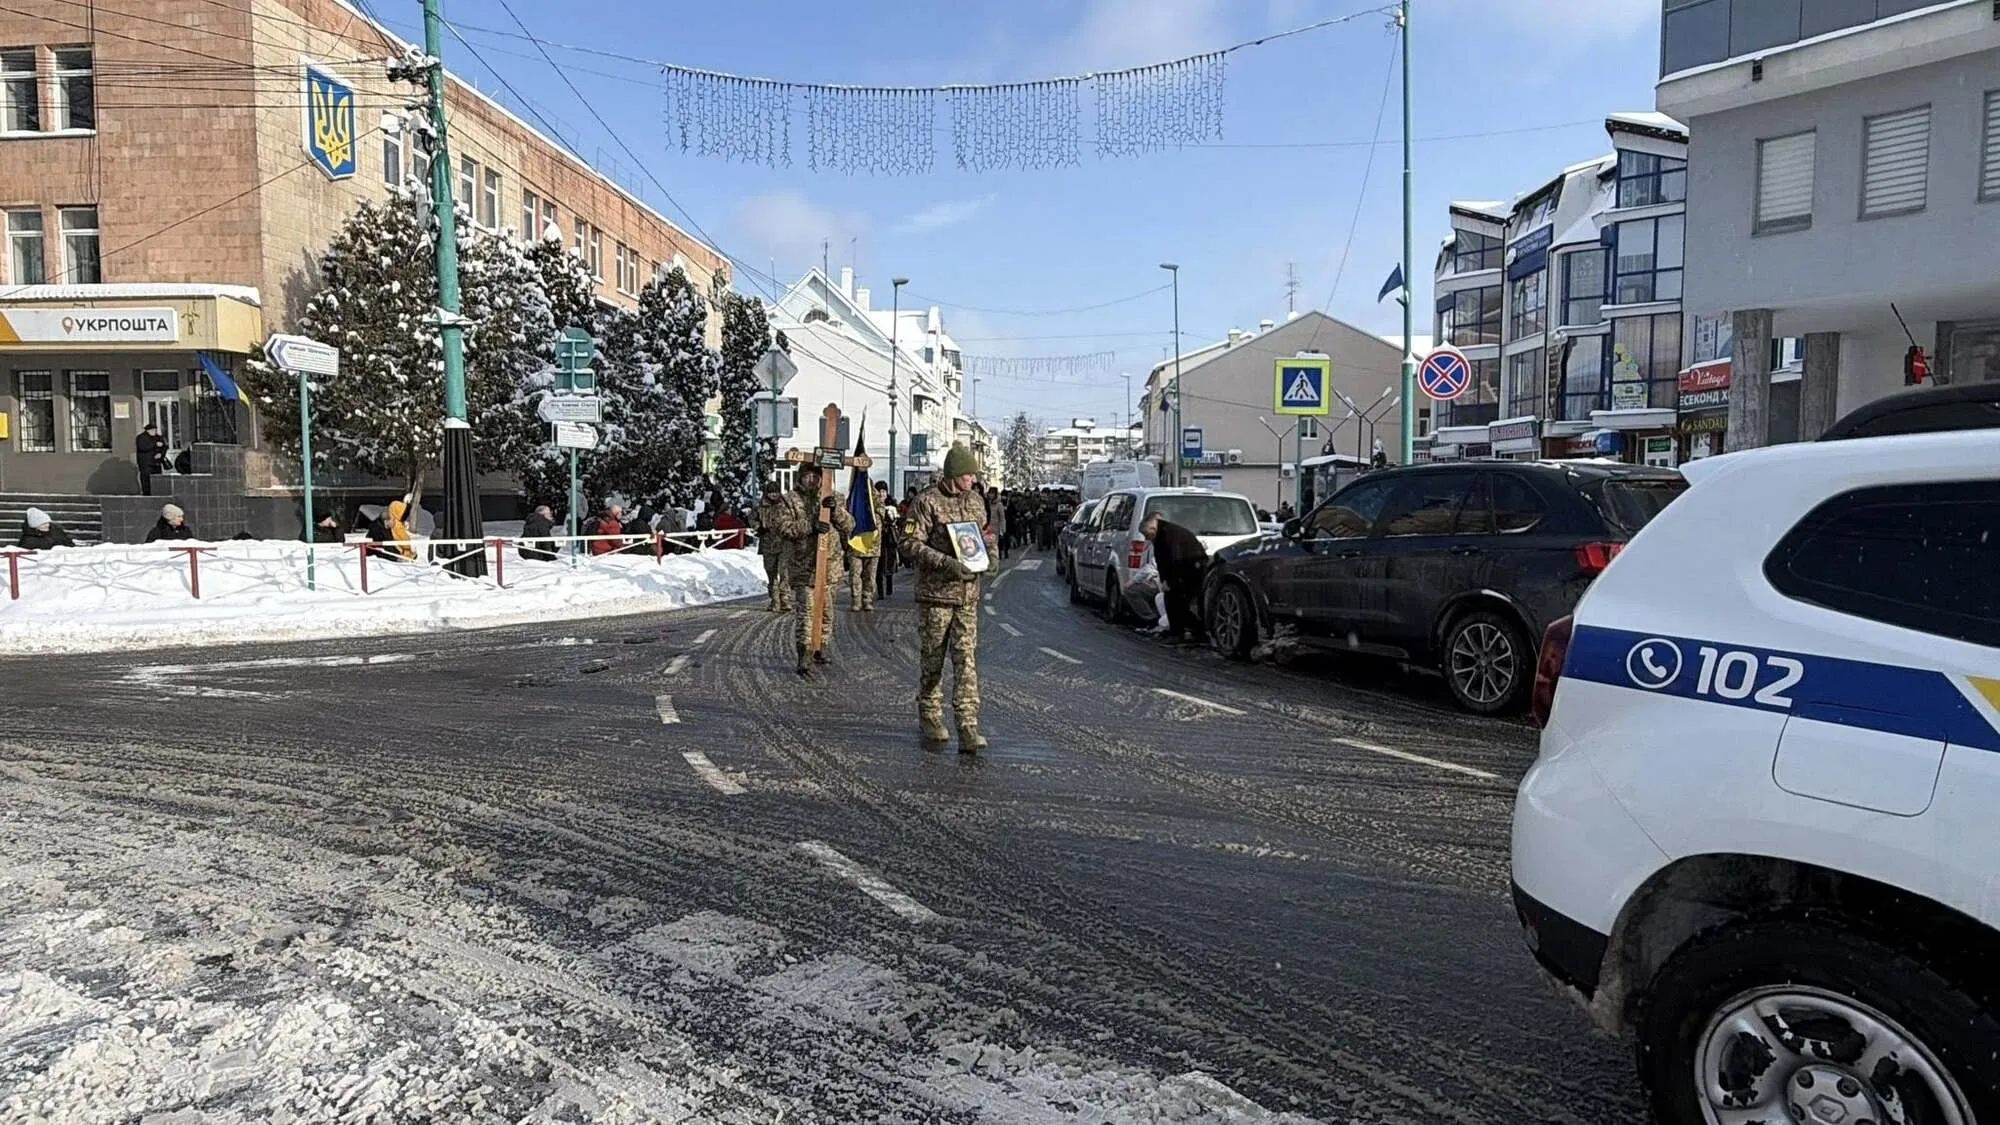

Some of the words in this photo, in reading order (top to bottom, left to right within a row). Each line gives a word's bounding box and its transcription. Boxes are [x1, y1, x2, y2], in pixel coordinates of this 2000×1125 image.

[75, 318, 168, 331] УКРПОШТА
[1691, 369, 1726, 386] Vintage
[1696, 646, 1804, 708] 102
